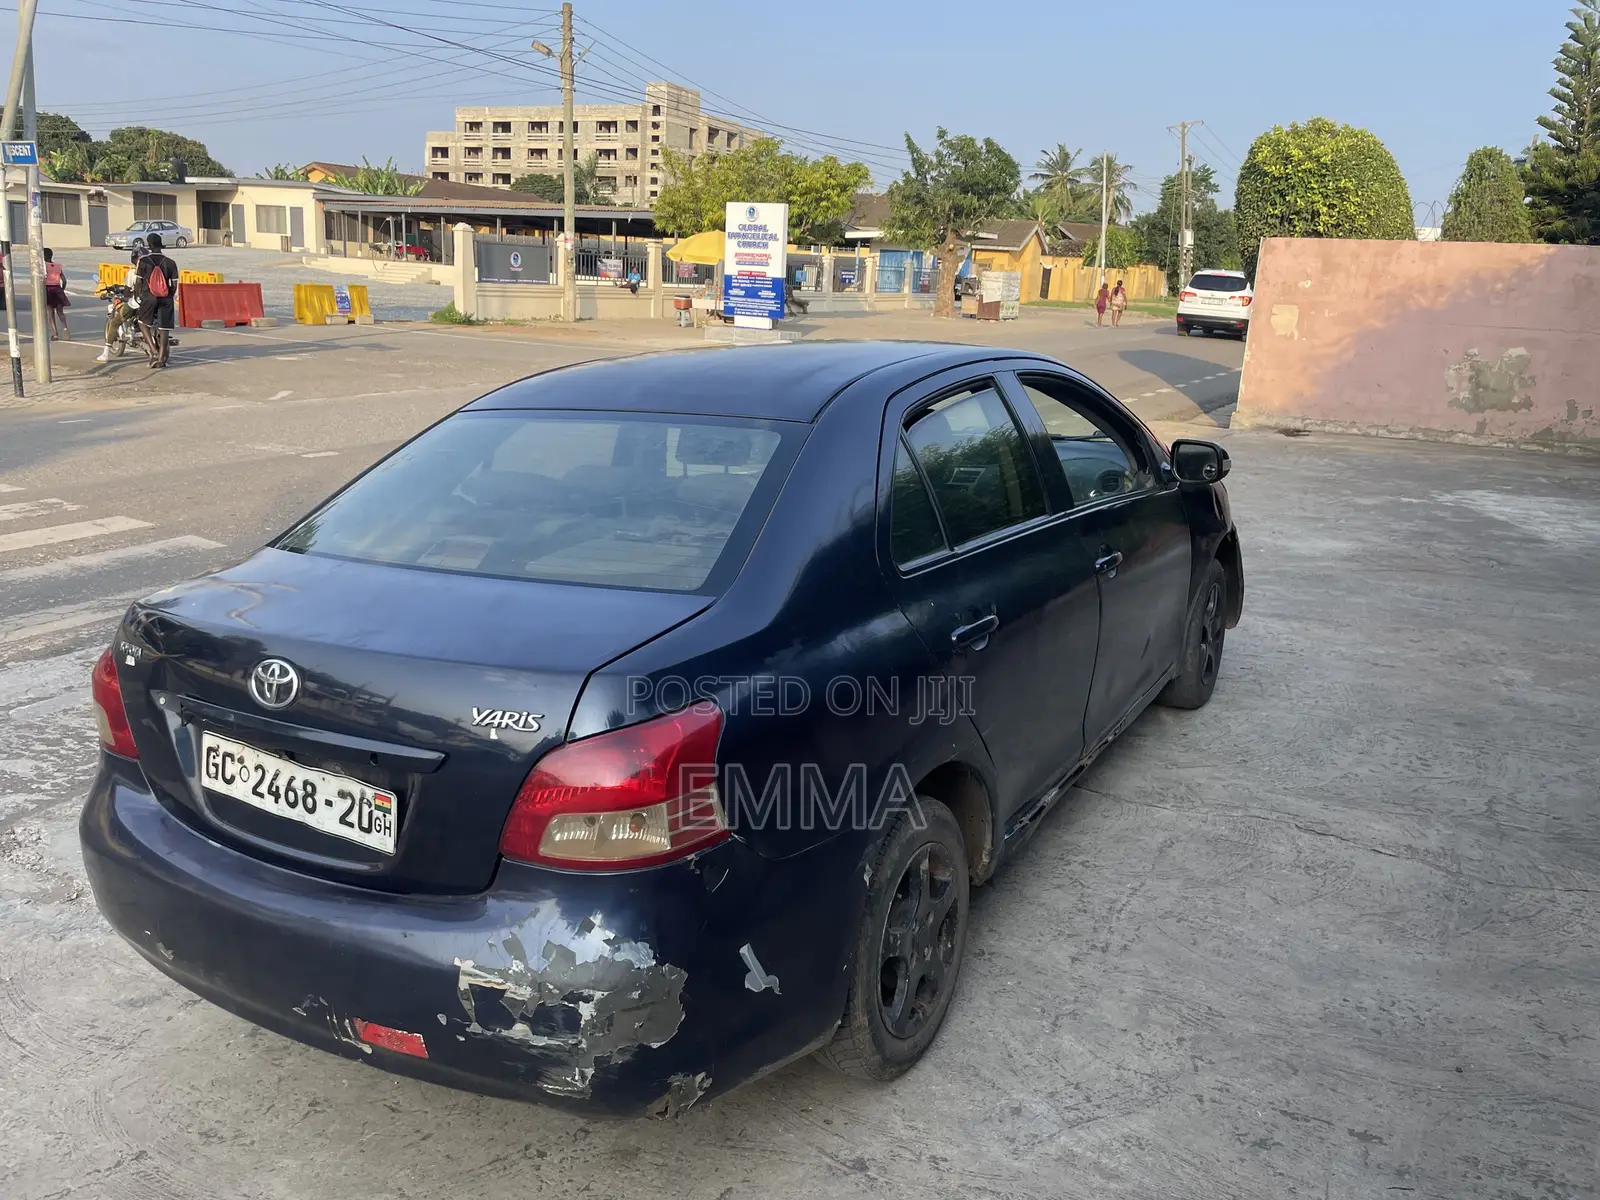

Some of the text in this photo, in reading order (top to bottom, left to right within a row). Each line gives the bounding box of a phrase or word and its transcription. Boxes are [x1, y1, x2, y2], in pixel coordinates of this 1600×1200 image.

[738, 224, 769, 232] GLOBAL
[737, 241, 769, 249] CHURCH
[472, 707, 544, 732] YARIS
[205, 744, 236, 785] GC
[374, 816, 392, 838] GH
